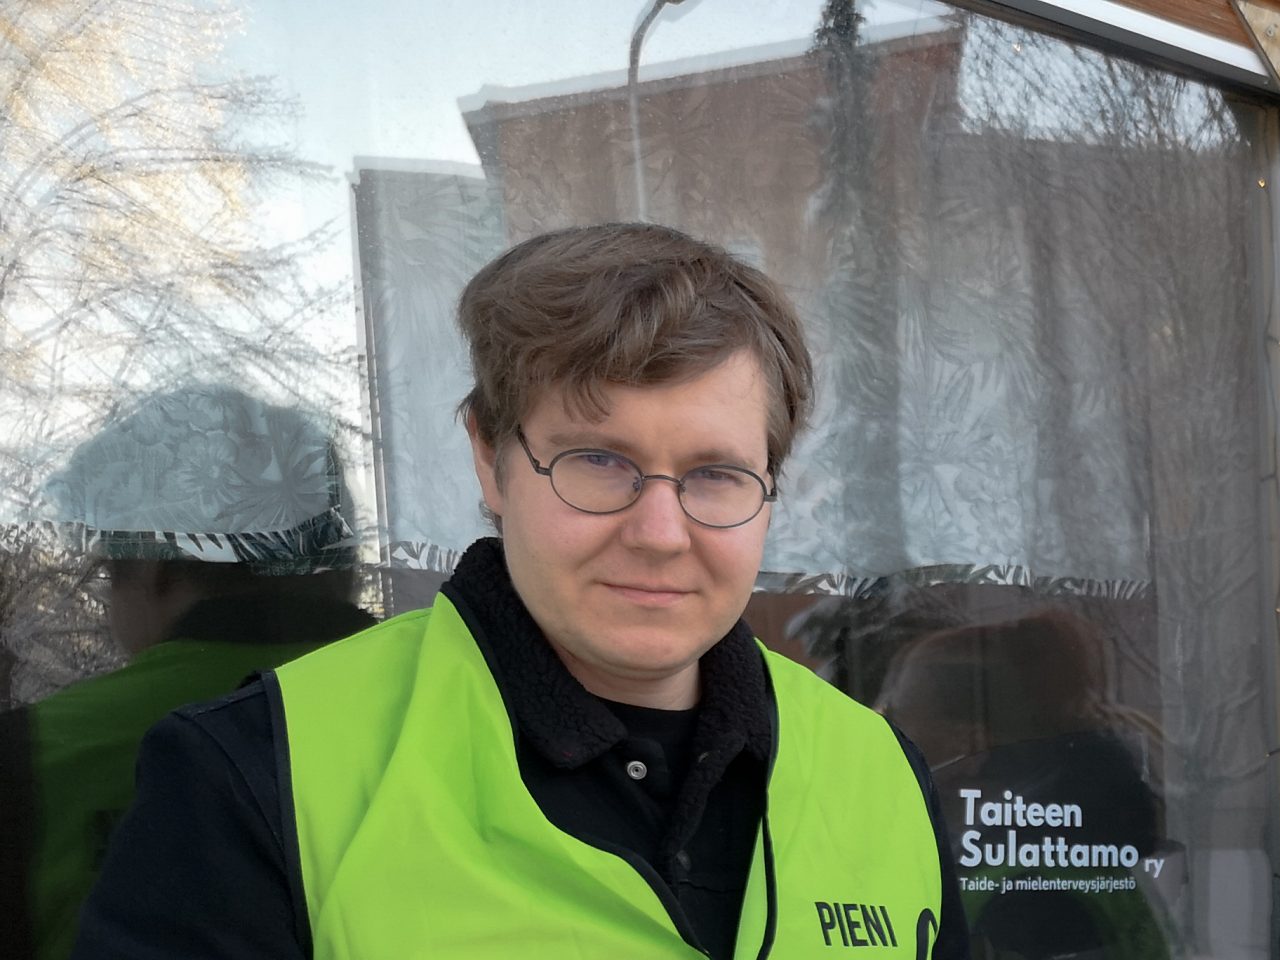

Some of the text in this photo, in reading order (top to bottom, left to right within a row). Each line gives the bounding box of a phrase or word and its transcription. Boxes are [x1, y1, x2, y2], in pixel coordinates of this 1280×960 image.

[959, 788, 1083, 828] Taiteen
[959, 829, 1165, 879] Sulattamo ry
[959, 876, 1137, 895] Taide- ja mielenterveysjärjestö
[814, 901, 898, 948] PIENI
